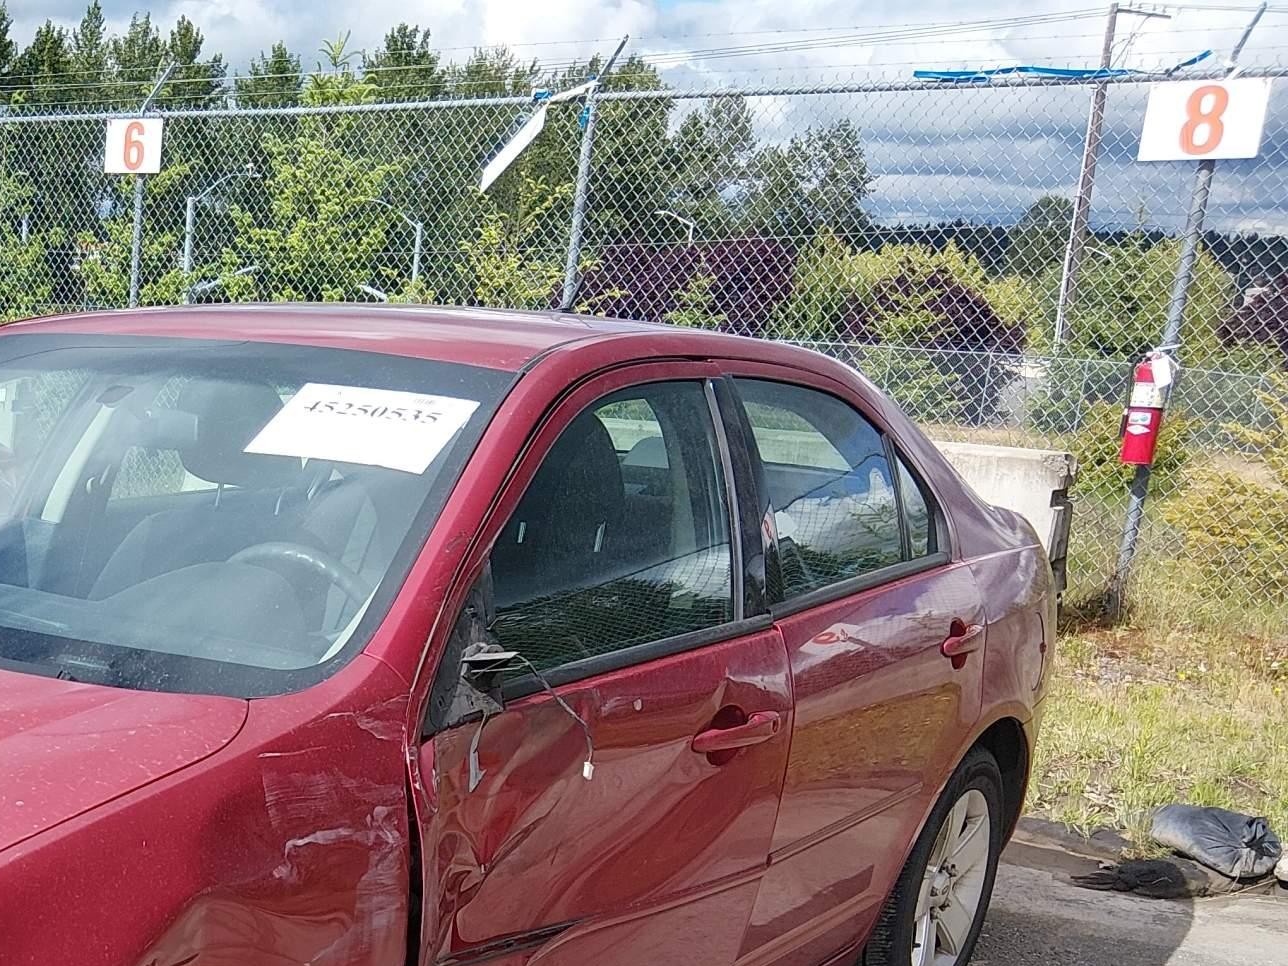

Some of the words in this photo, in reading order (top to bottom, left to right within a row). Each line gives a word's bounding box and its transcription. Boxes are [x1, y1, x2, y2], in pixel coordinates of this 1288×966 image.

[1179, 84, 1230, 156] 8
[123, 121, 145, 171] 6
[304, 400, 443, 424] 45250535
